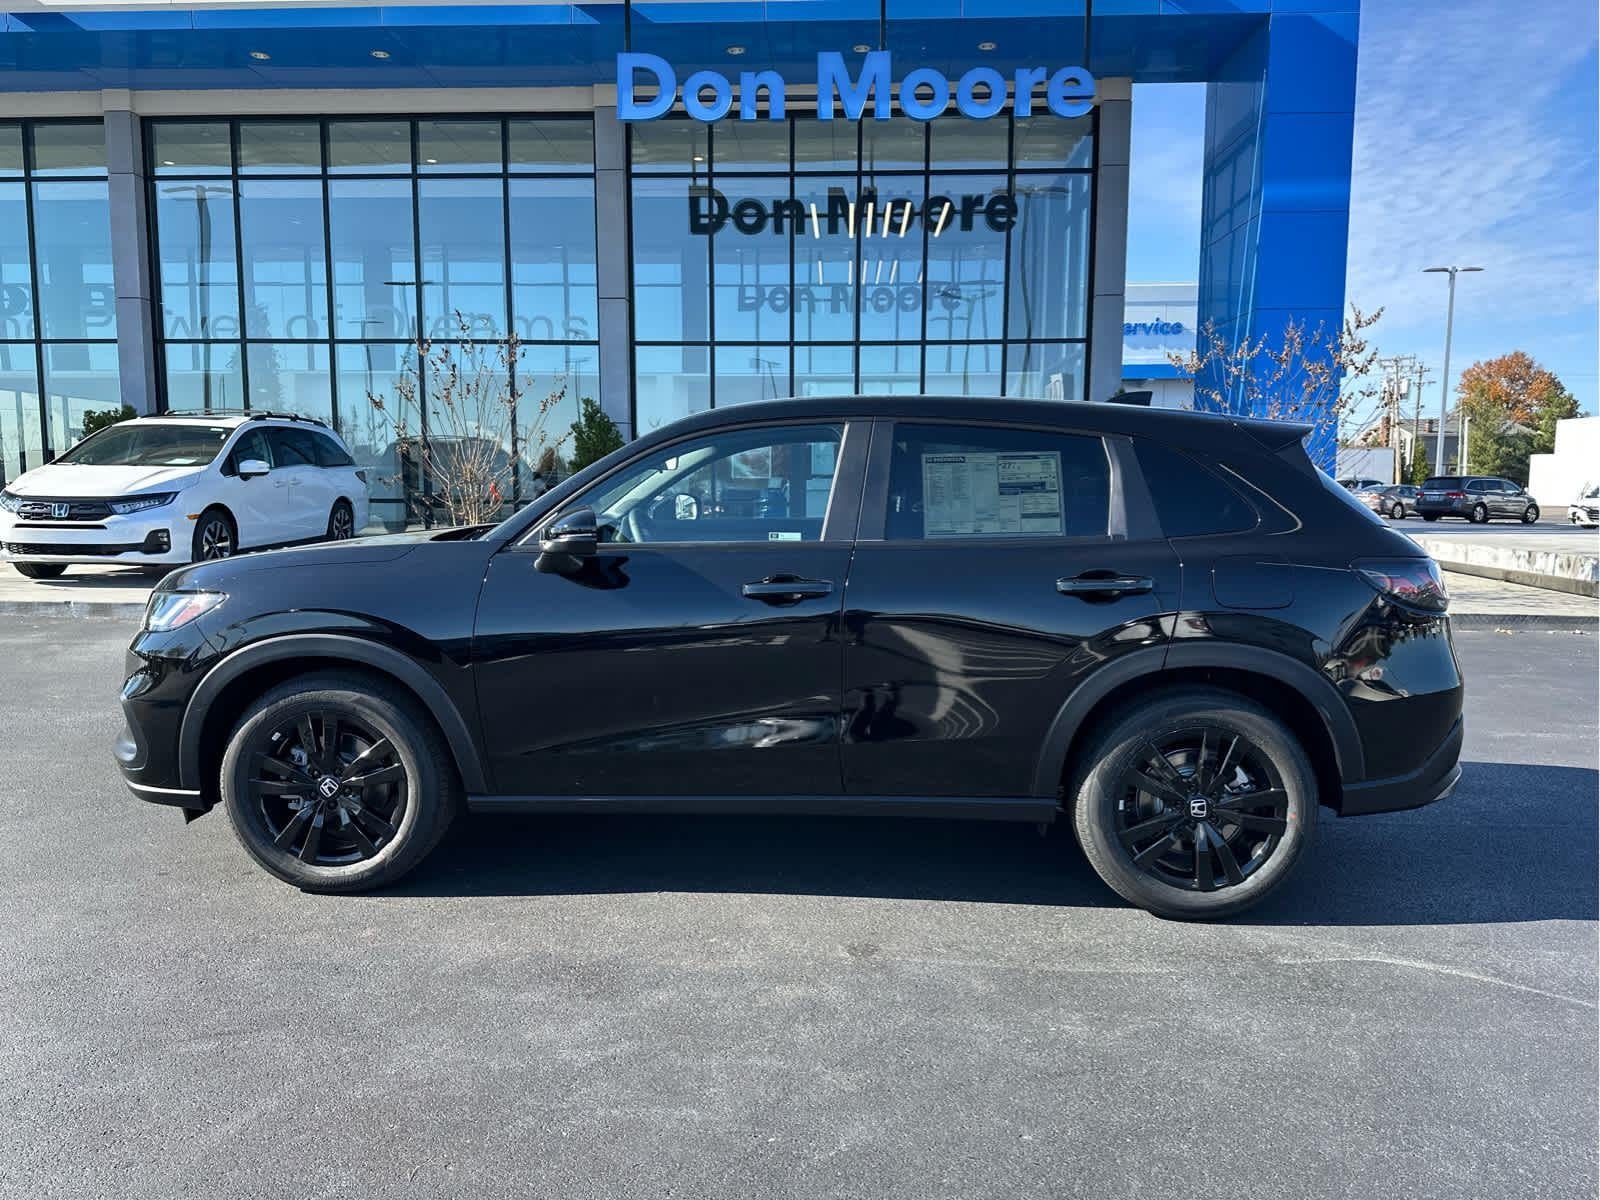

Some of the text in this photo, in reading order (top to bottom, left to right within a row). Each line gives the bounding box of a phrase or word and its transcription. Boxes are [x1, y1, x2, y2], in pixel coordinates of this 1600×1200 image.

[616, 51, 1096, 122] Don Moore
[688, 186, 1018, 235] Don Moore
[1123, 317, 1184, 336] ervice
